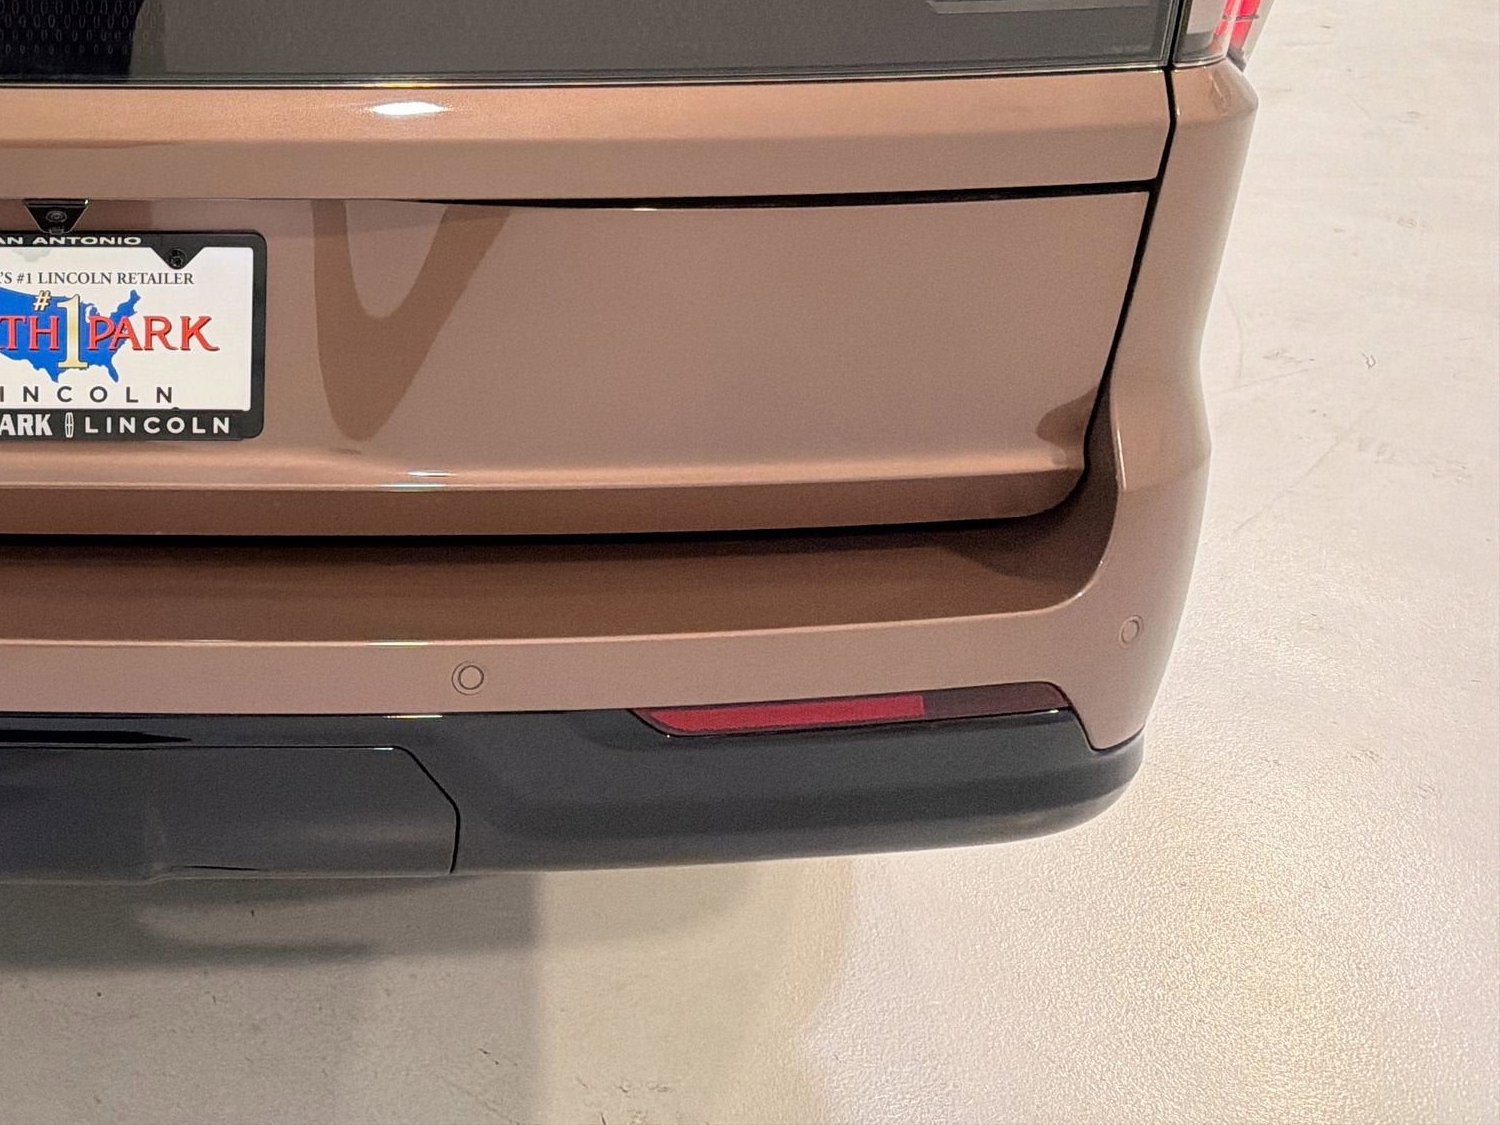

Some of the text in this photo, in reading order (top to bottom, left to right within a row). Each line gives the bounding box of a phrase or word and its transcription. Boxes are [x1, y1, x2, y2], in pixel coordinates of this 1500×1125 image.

[33, 237, 142, 245] ANTONIO
[17, 272, 34, 285] #1
[39, 272, 113, 285] LINCOLN
[117, 272, 195, 285] RETAILER
[88, 315, 220, 351] PARK
[85, 416, 230, 434] LINCOLN
